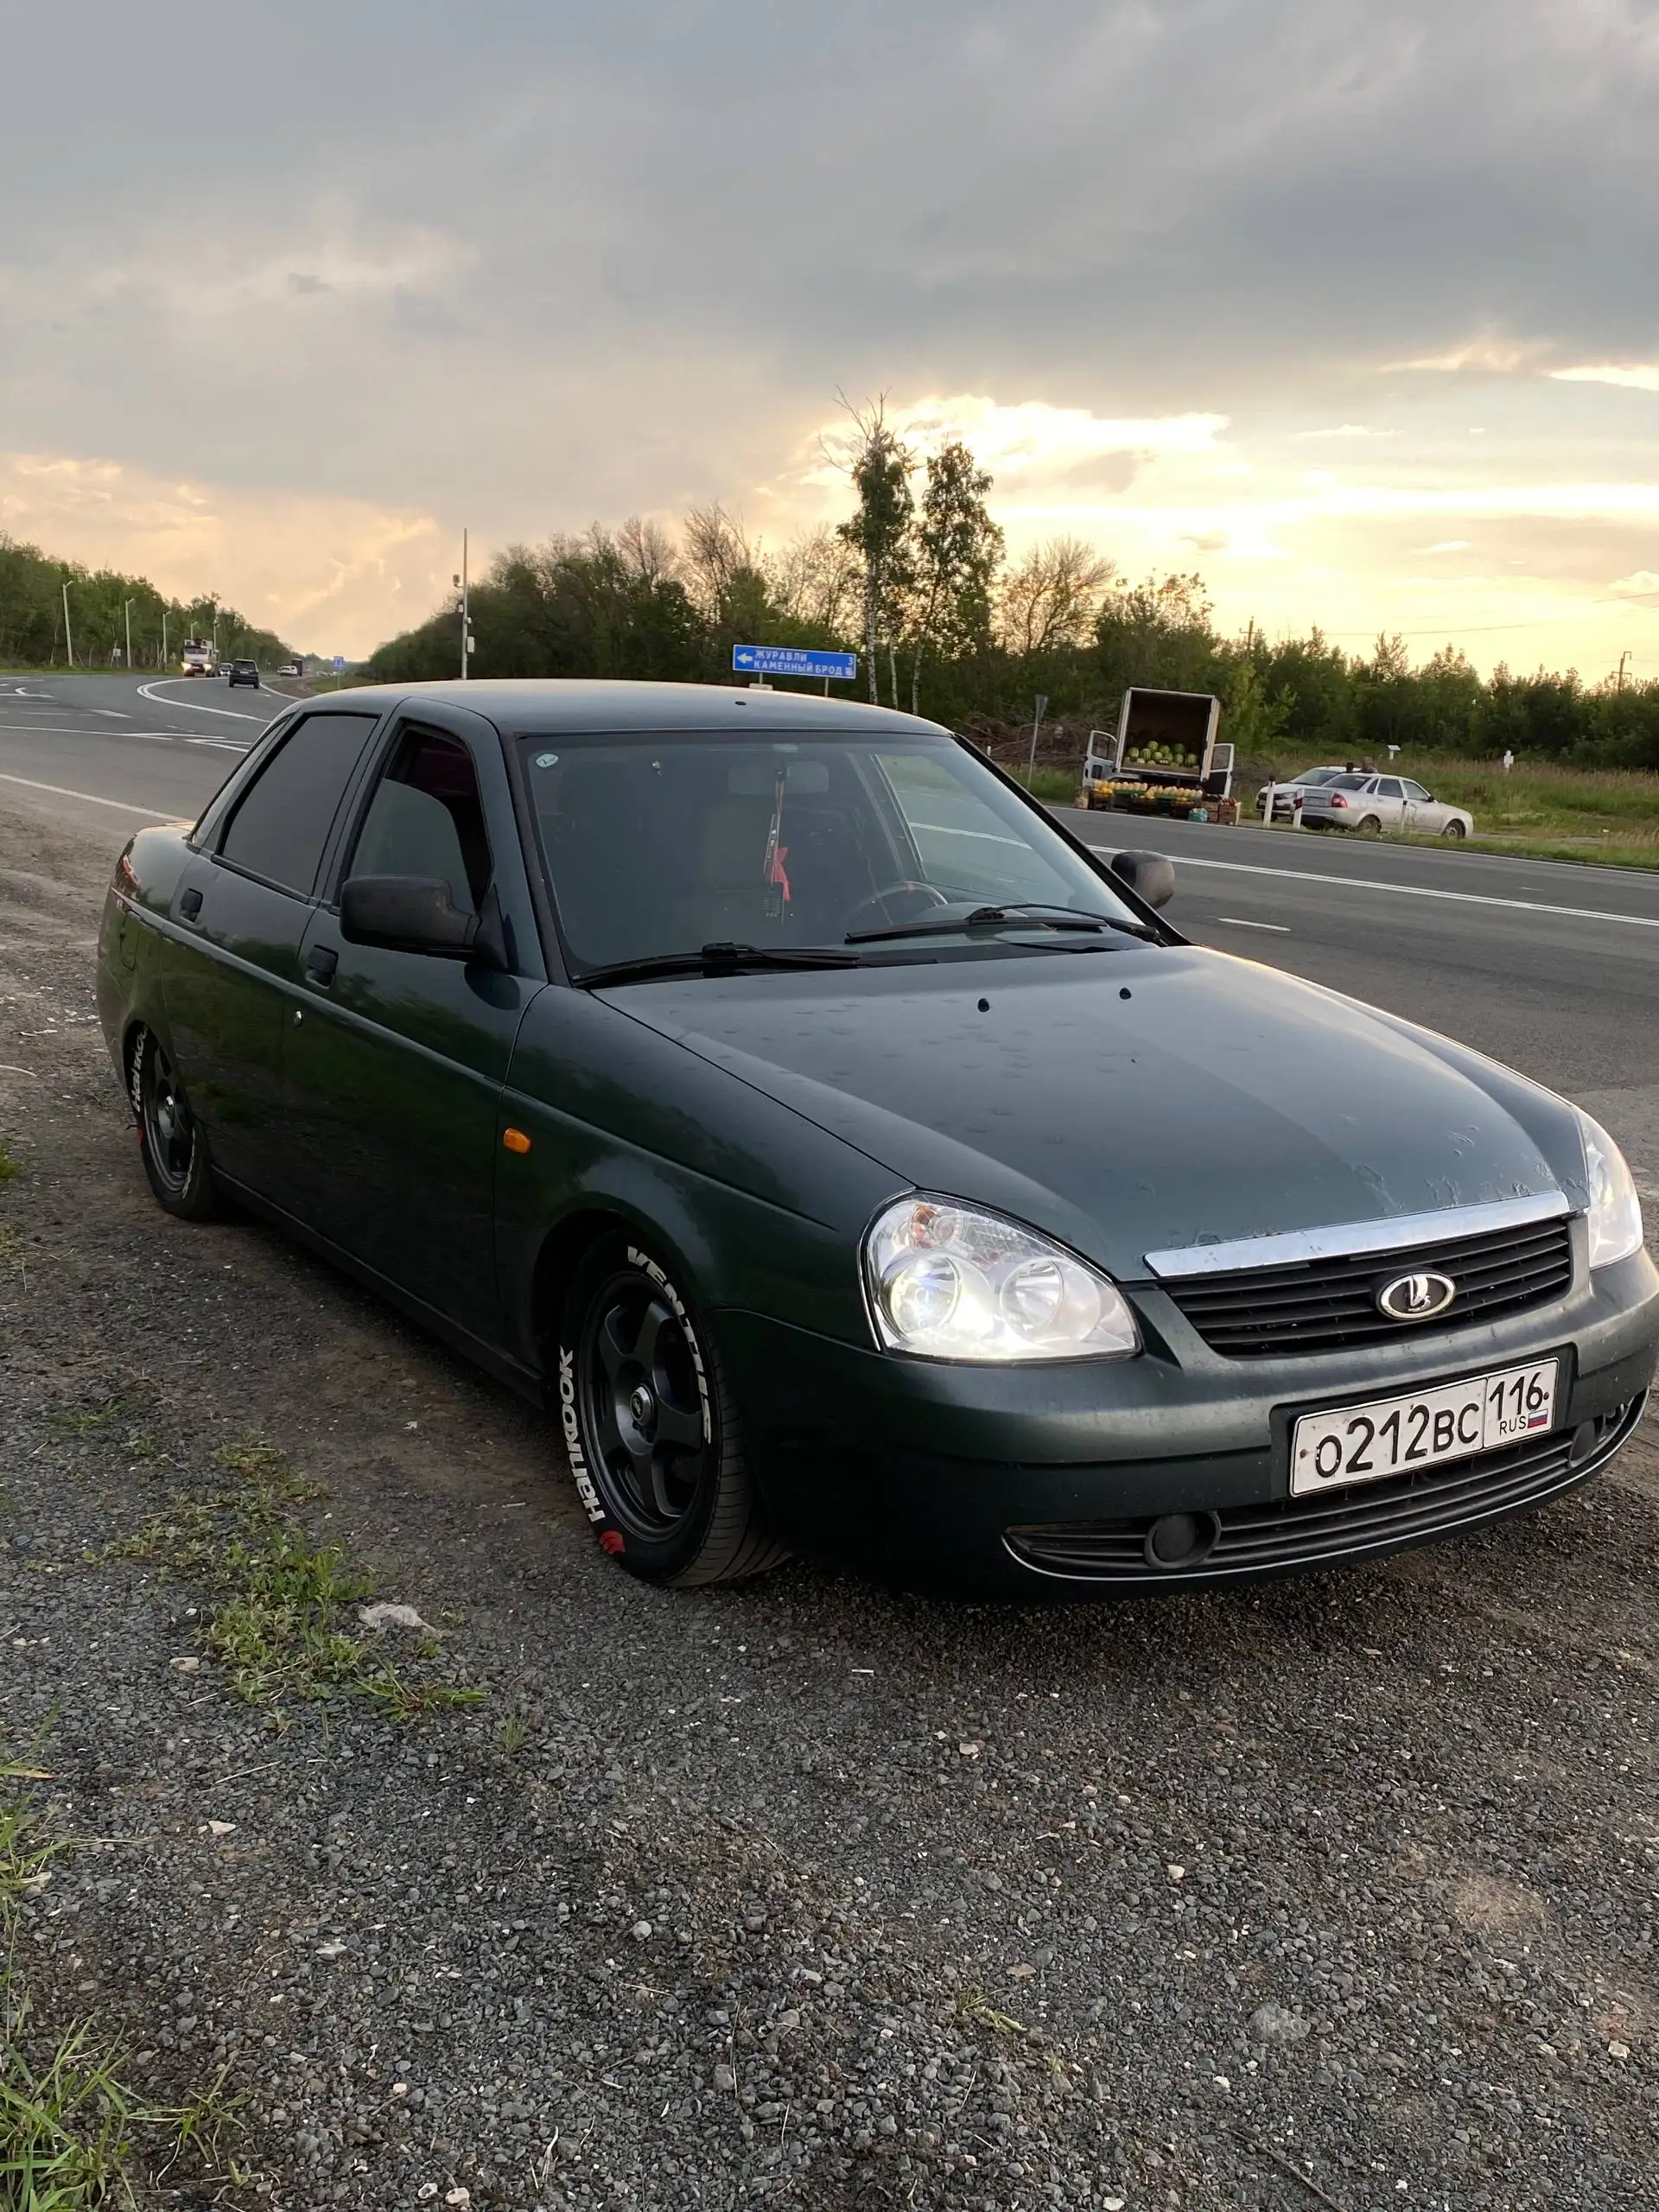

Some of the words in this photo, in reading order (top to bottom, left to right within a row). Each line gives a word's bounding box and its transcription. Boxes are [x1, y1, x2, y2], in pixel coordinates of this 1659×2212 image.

[755, 650, 807, 662] ЖУРАВЛИ
[848, 657, 854, 665] 3
[753, 661, 813, 673] КАМЕННЫЙ
[815, 664, 842, 676] БРОД
[1489, 1370, 1544, 1421] 116
[1499, 1414, 1527, 1436] RUS
